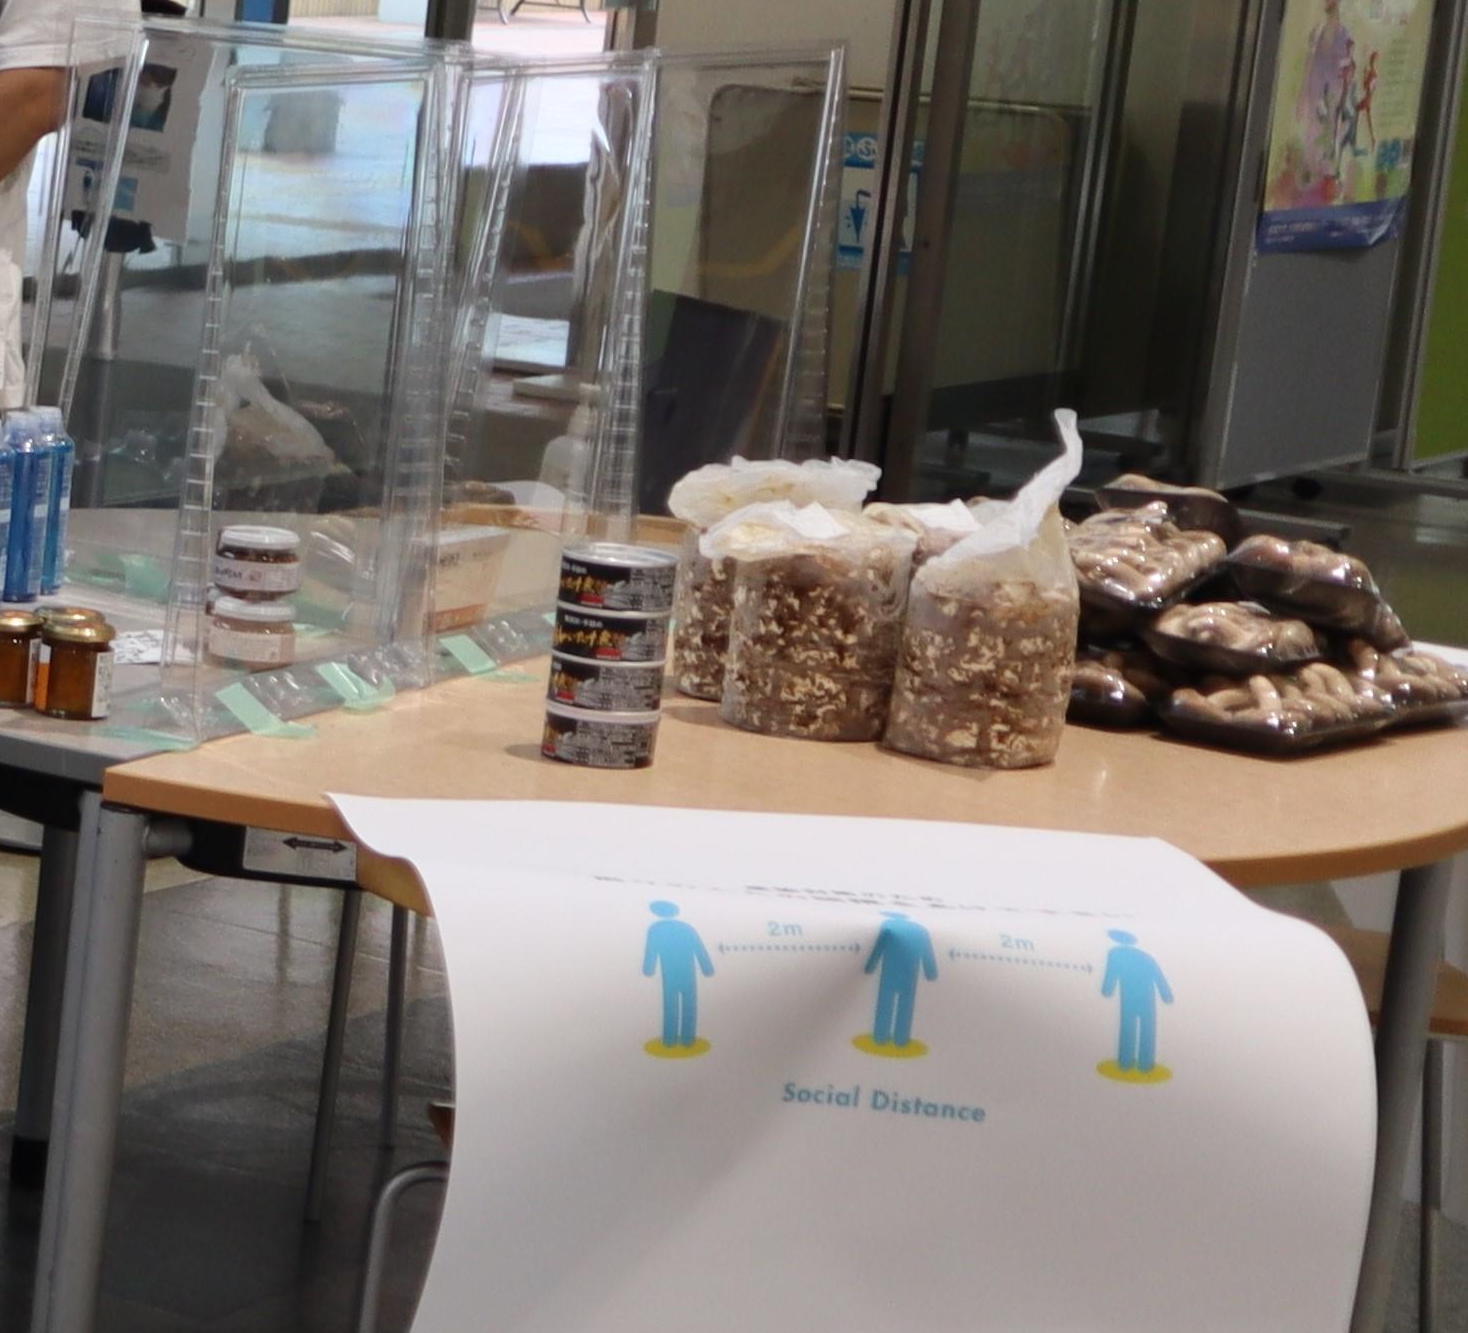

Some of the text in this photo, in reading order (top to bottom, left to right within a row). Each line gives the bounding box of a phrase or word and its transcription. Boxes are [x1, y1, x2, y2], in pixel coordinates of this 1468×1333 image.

[767, 920, 804, 938] 2m
[999, 934, 1035, 952] 2m
[782, 1081, 987, 1124] Social Distance
